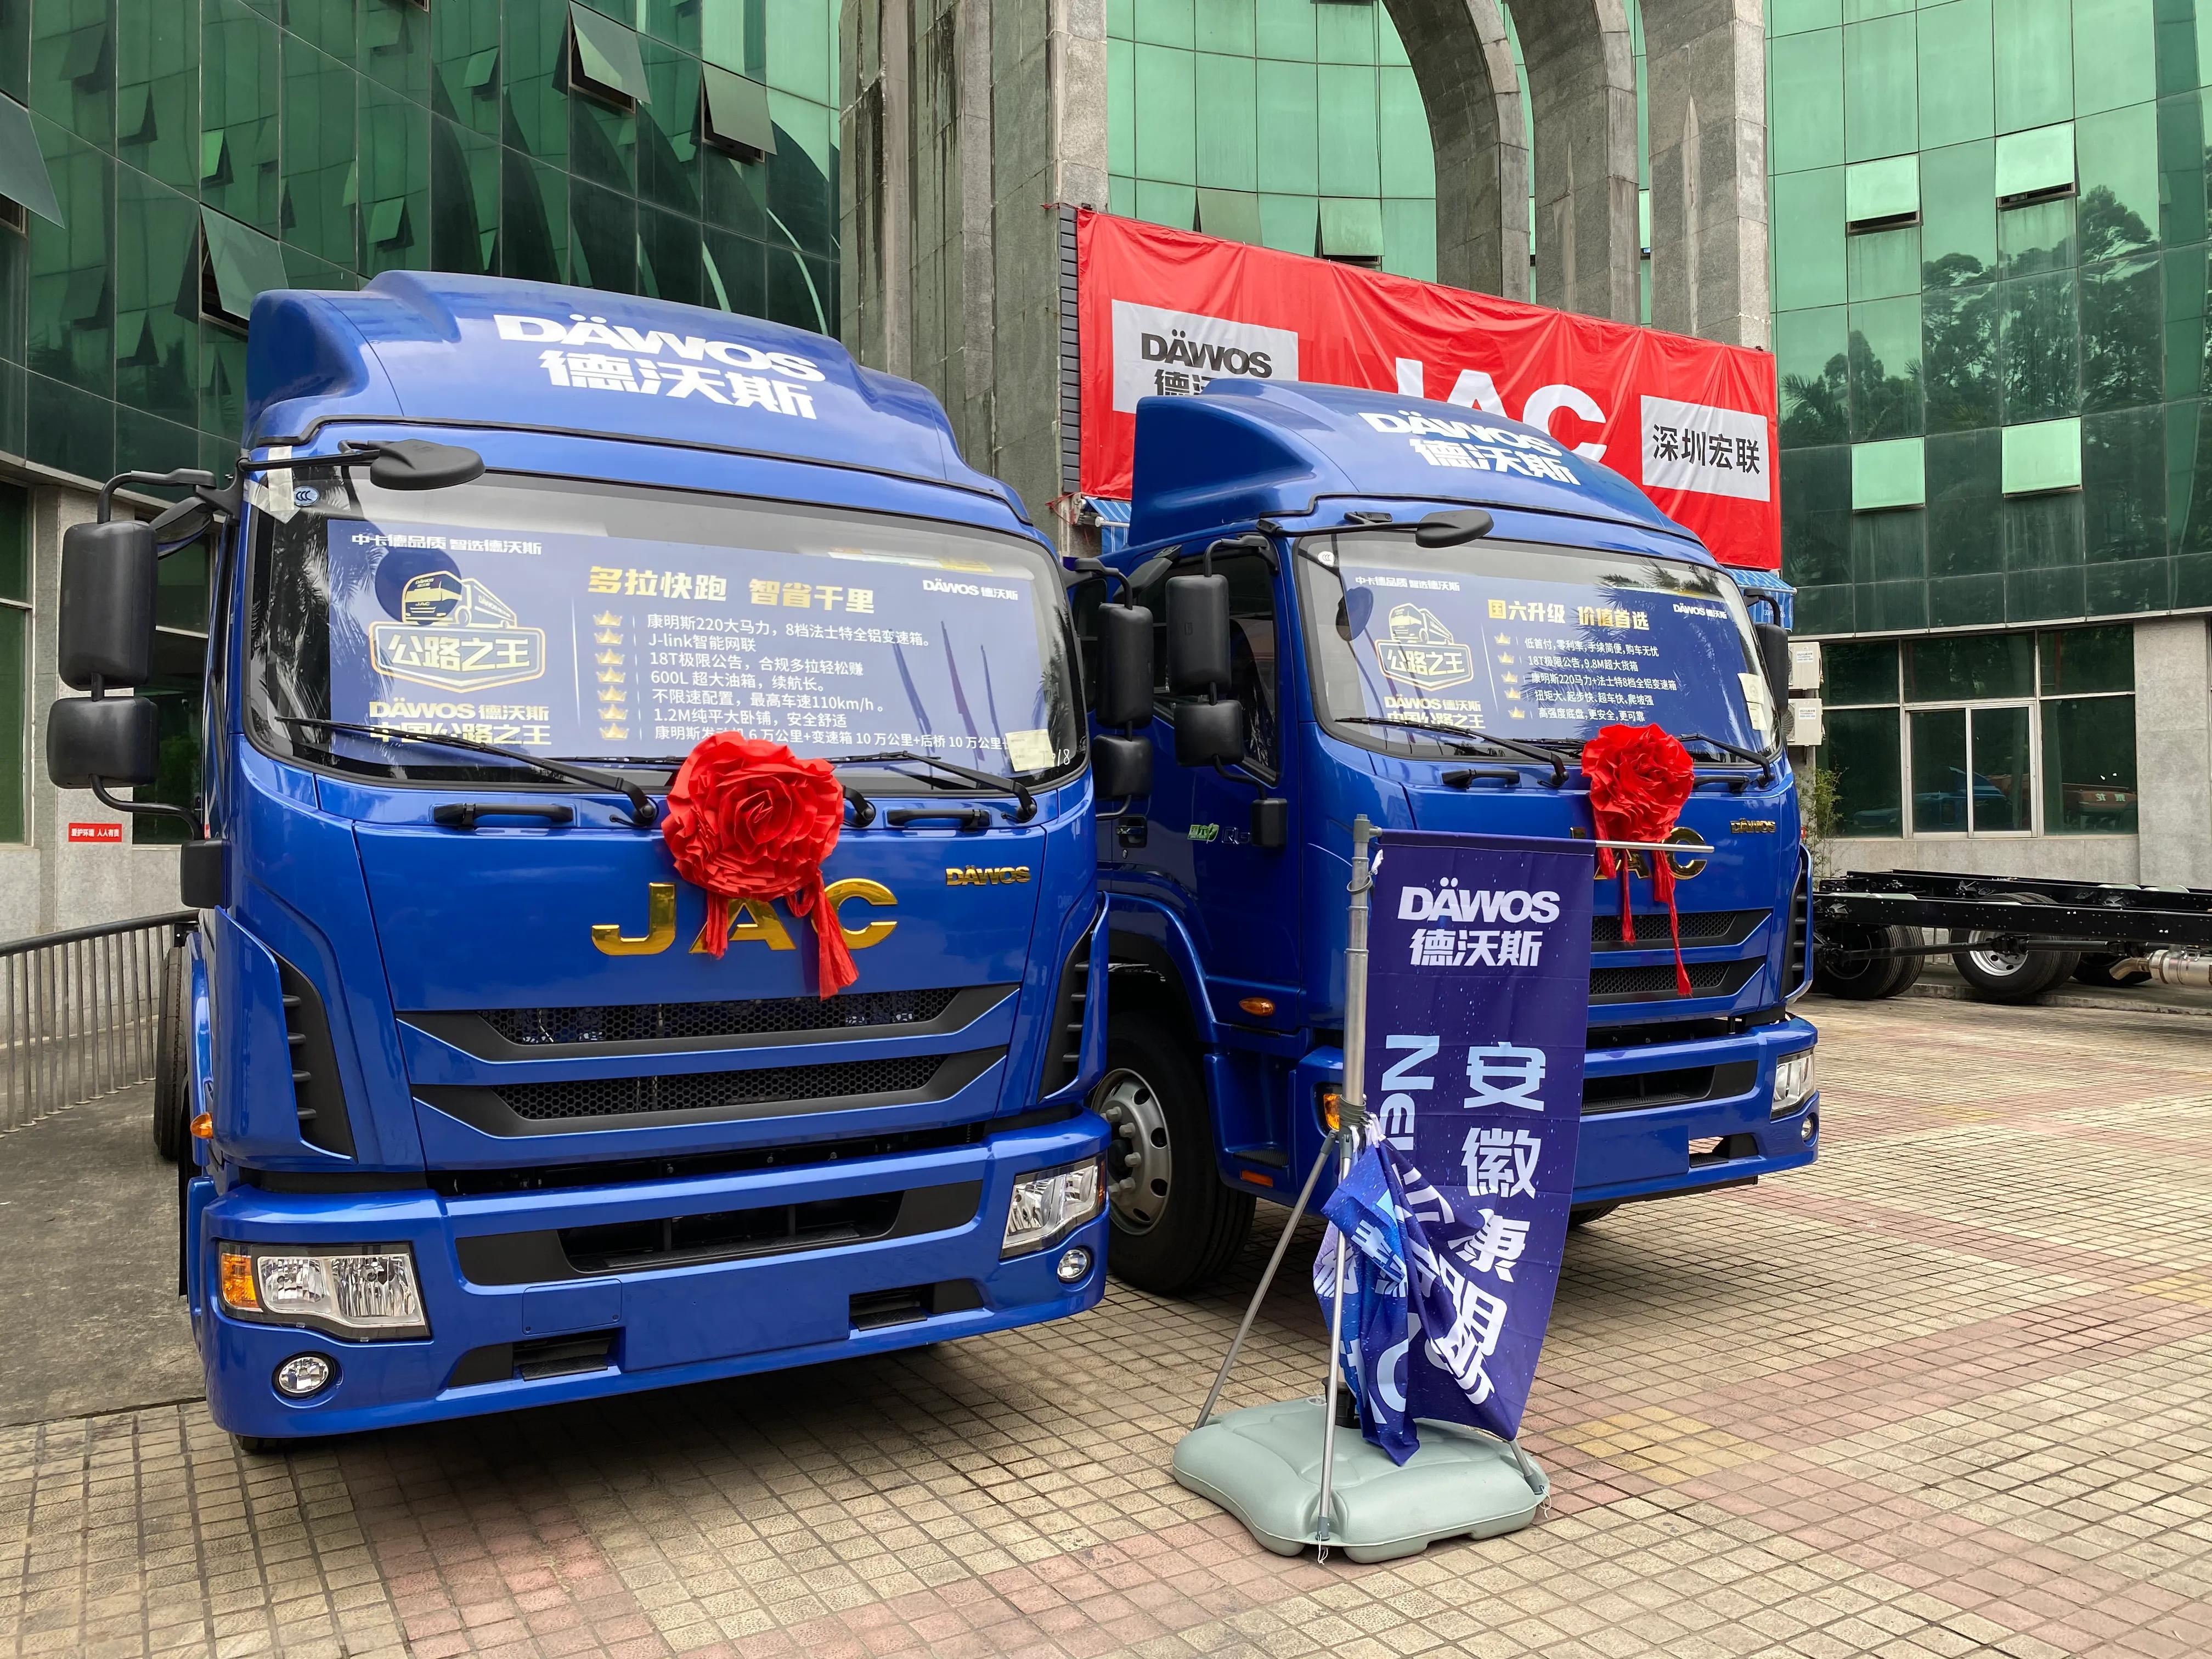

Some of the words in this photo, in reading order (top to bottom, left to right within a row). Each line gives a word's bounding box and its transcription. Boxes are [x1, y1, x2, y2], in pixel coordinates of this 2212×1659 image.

[493, 314, 826, 382] DÄWOS
[1141, 329, 1272, 378] DÄWOS
[538, 349, 817, 420] 德沃斯
[1358, 409, 1562, 457] DÄWOS
[1409, 438, 1581, 486] 德沃斯
[1652, 423, 1760, 475] 深圳宏联
[352, 533, 447, 549] 中卡德品质
[450, 539, 542, 555] 智选德沃斯
[588, 566, 726, 601] 多拉快跑
[749, 578, 874, 614] 智省千里
[922, 578, 979, 596] DÄWOS
[980, 586, 1018, 601] 德沃斯
[1487, 599, 1566, 624] 国六升级
[1578, 606, 1650, 631] 价值首选
[1673, 602, 1705, 616] DÄWOS
[388, 634, 530, 672] 公路之王
[649, 633, 757, 652] J-link智能网联
[650, 652, 864, 676] 18T极限公告，合规多拉轻松赚
[1387, 649, 1465, 676] 公路之王
[369, 697, 476, 720] DÄWOS
[478, 704, 549, 721] 德沃斯
[1384, 693, 1442, 710] DÄWOS
[1442, 699, 1482, 712] 德沃斯
[370, 721, 552, 745] 中国公路之王
[654, 708, 848, 729] 1.2M纯平大卧铺，安全舒适
[1730, 817, 1776, 834] DÄWOS
[946, 865, 1031, 887] DÄWOS
[1397, 877, 1560, 923] DÄWOS
[591, 878, 899, 956] JAC
[1409, 928, 1543, 967] 德沃斯
